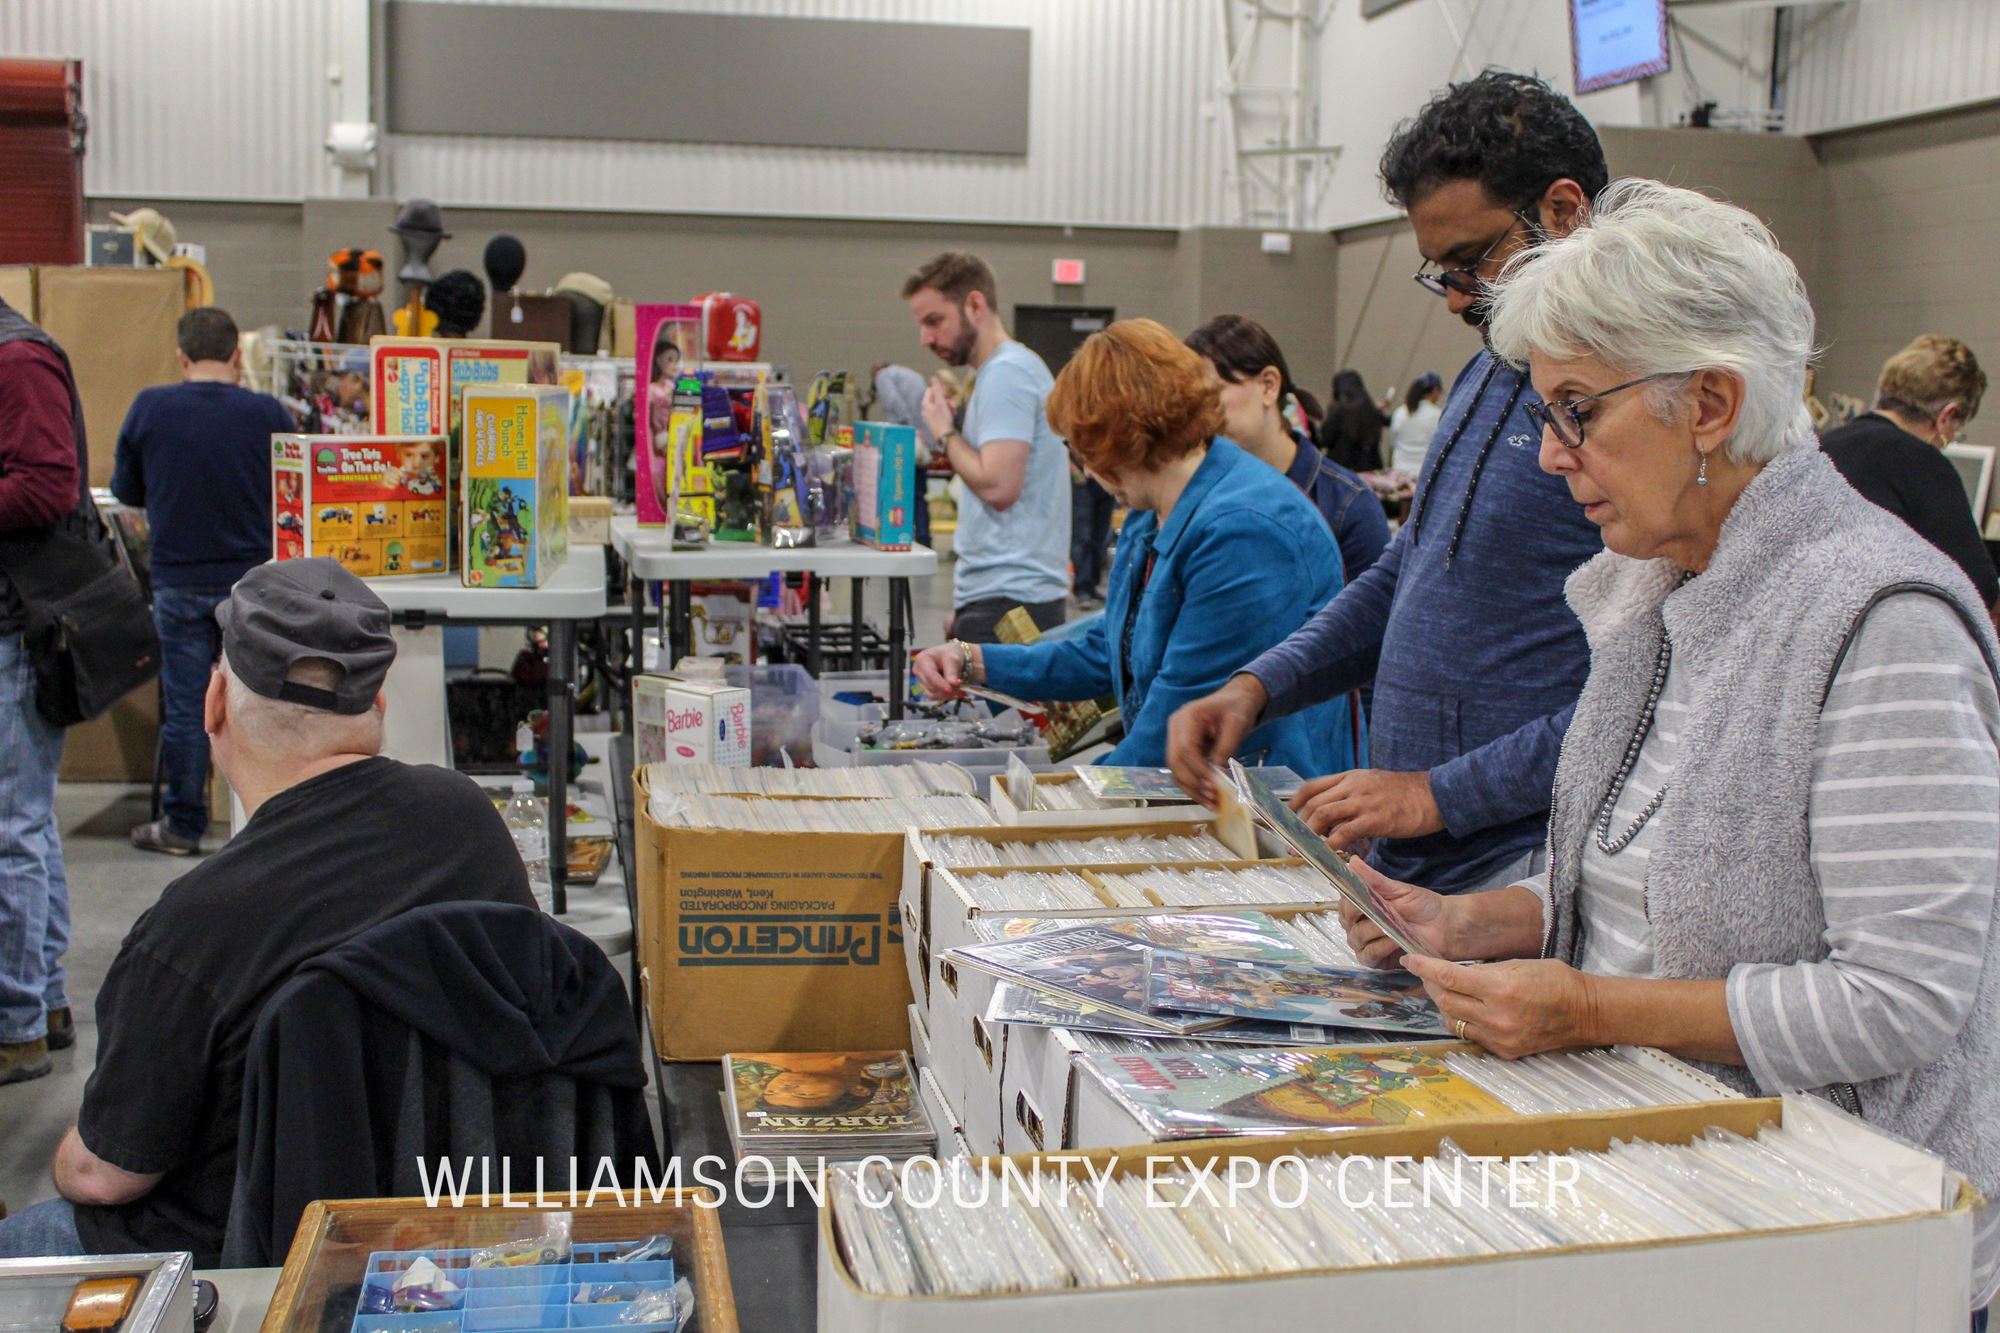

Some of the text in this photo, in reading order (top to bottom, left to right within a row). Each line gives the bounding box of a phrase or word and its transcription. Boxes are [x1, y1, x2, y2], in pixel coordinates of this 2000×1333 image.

[501, 419, 514, 457] Bunch
[514, 404, 528, 471] Honey Hill
[340, 447, 382, 460] Tree Tots
[341, 461, 355, 473] On
[354, 460, 372, 472] The
[666, 707, 704, 733] Barbie
[729, 702, 747, 749] Barbie
[680, 886, 774, 899] Kent, Washington
[680, 900, 836, 911] PACKAGING INCORPORATED
[758, 1115, 913, 1128] TARZAN
